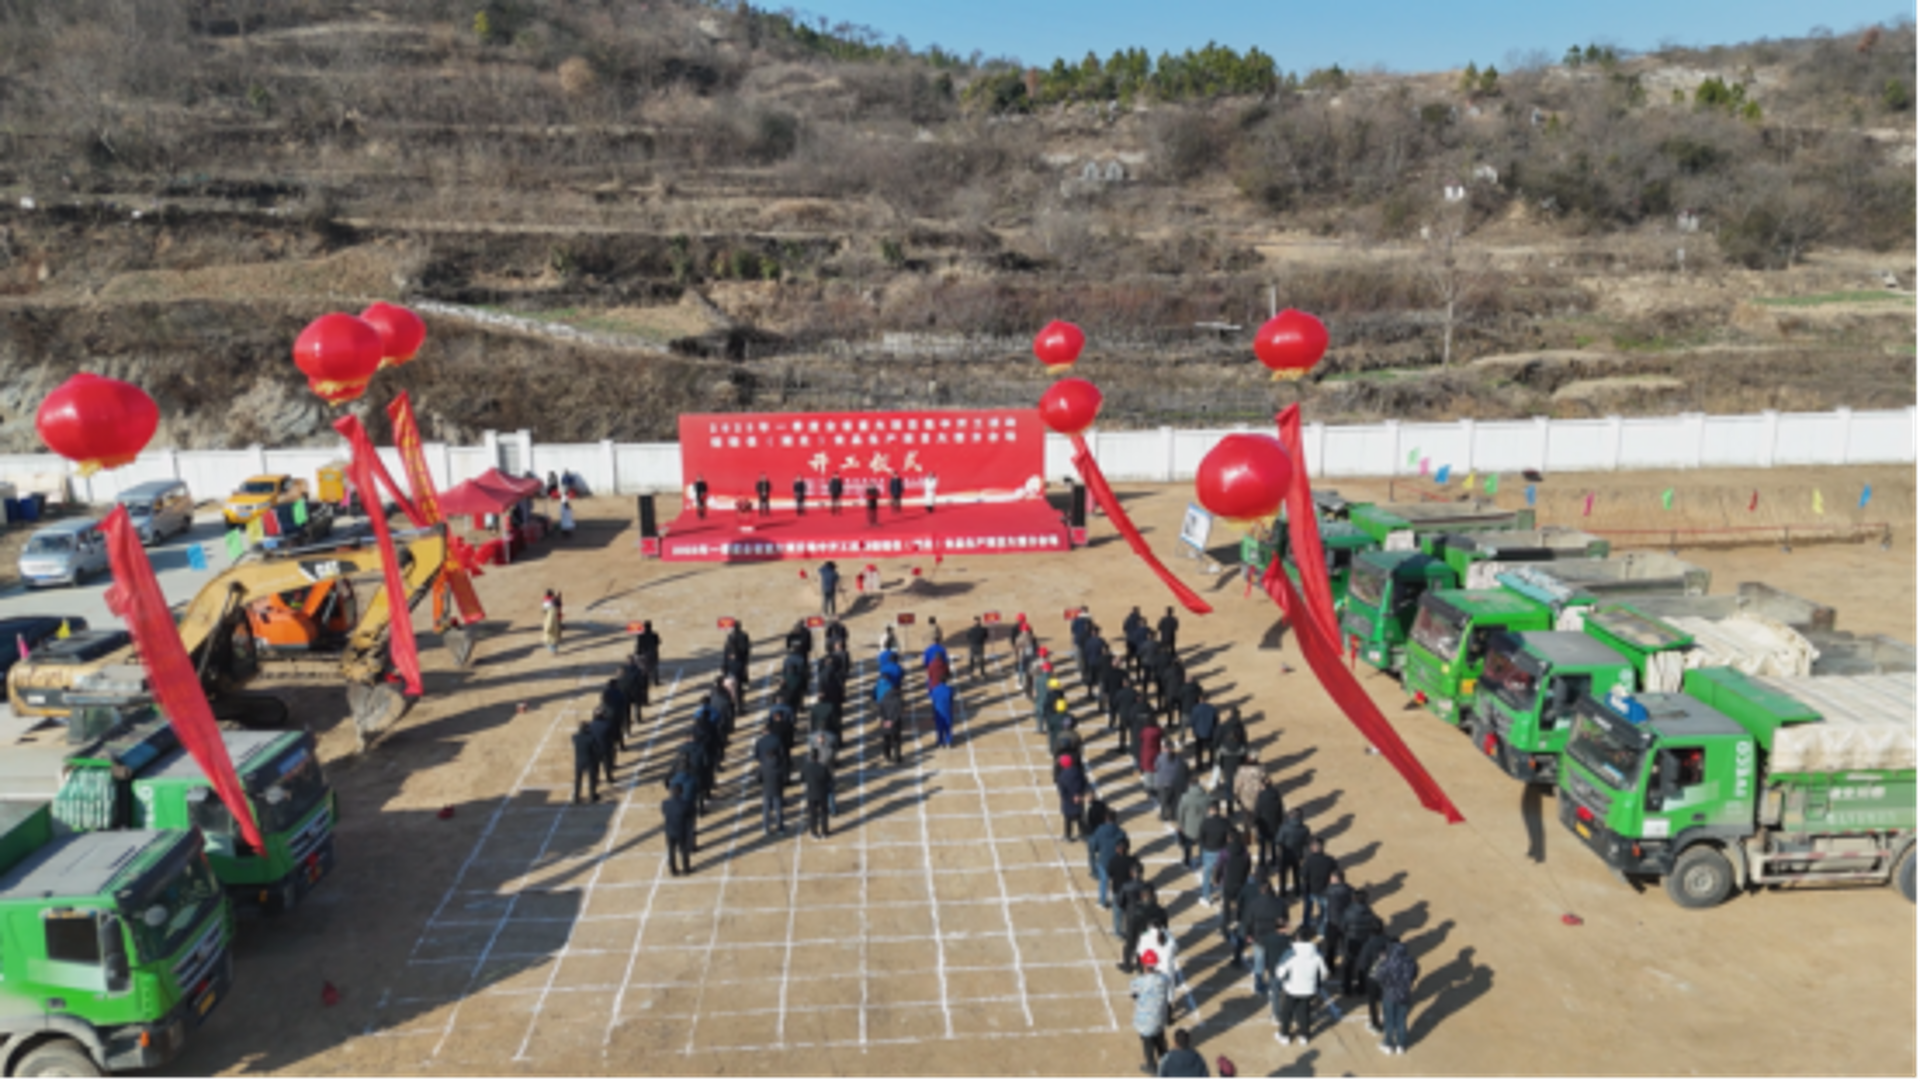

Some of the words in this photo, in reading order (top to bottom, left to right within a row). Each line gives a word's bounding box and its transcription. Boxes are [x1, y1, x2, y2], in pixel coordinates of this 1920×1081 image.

[807, 450, 923, 474] 开工仪式
[1735, 741, 1752, 797] IVECO
